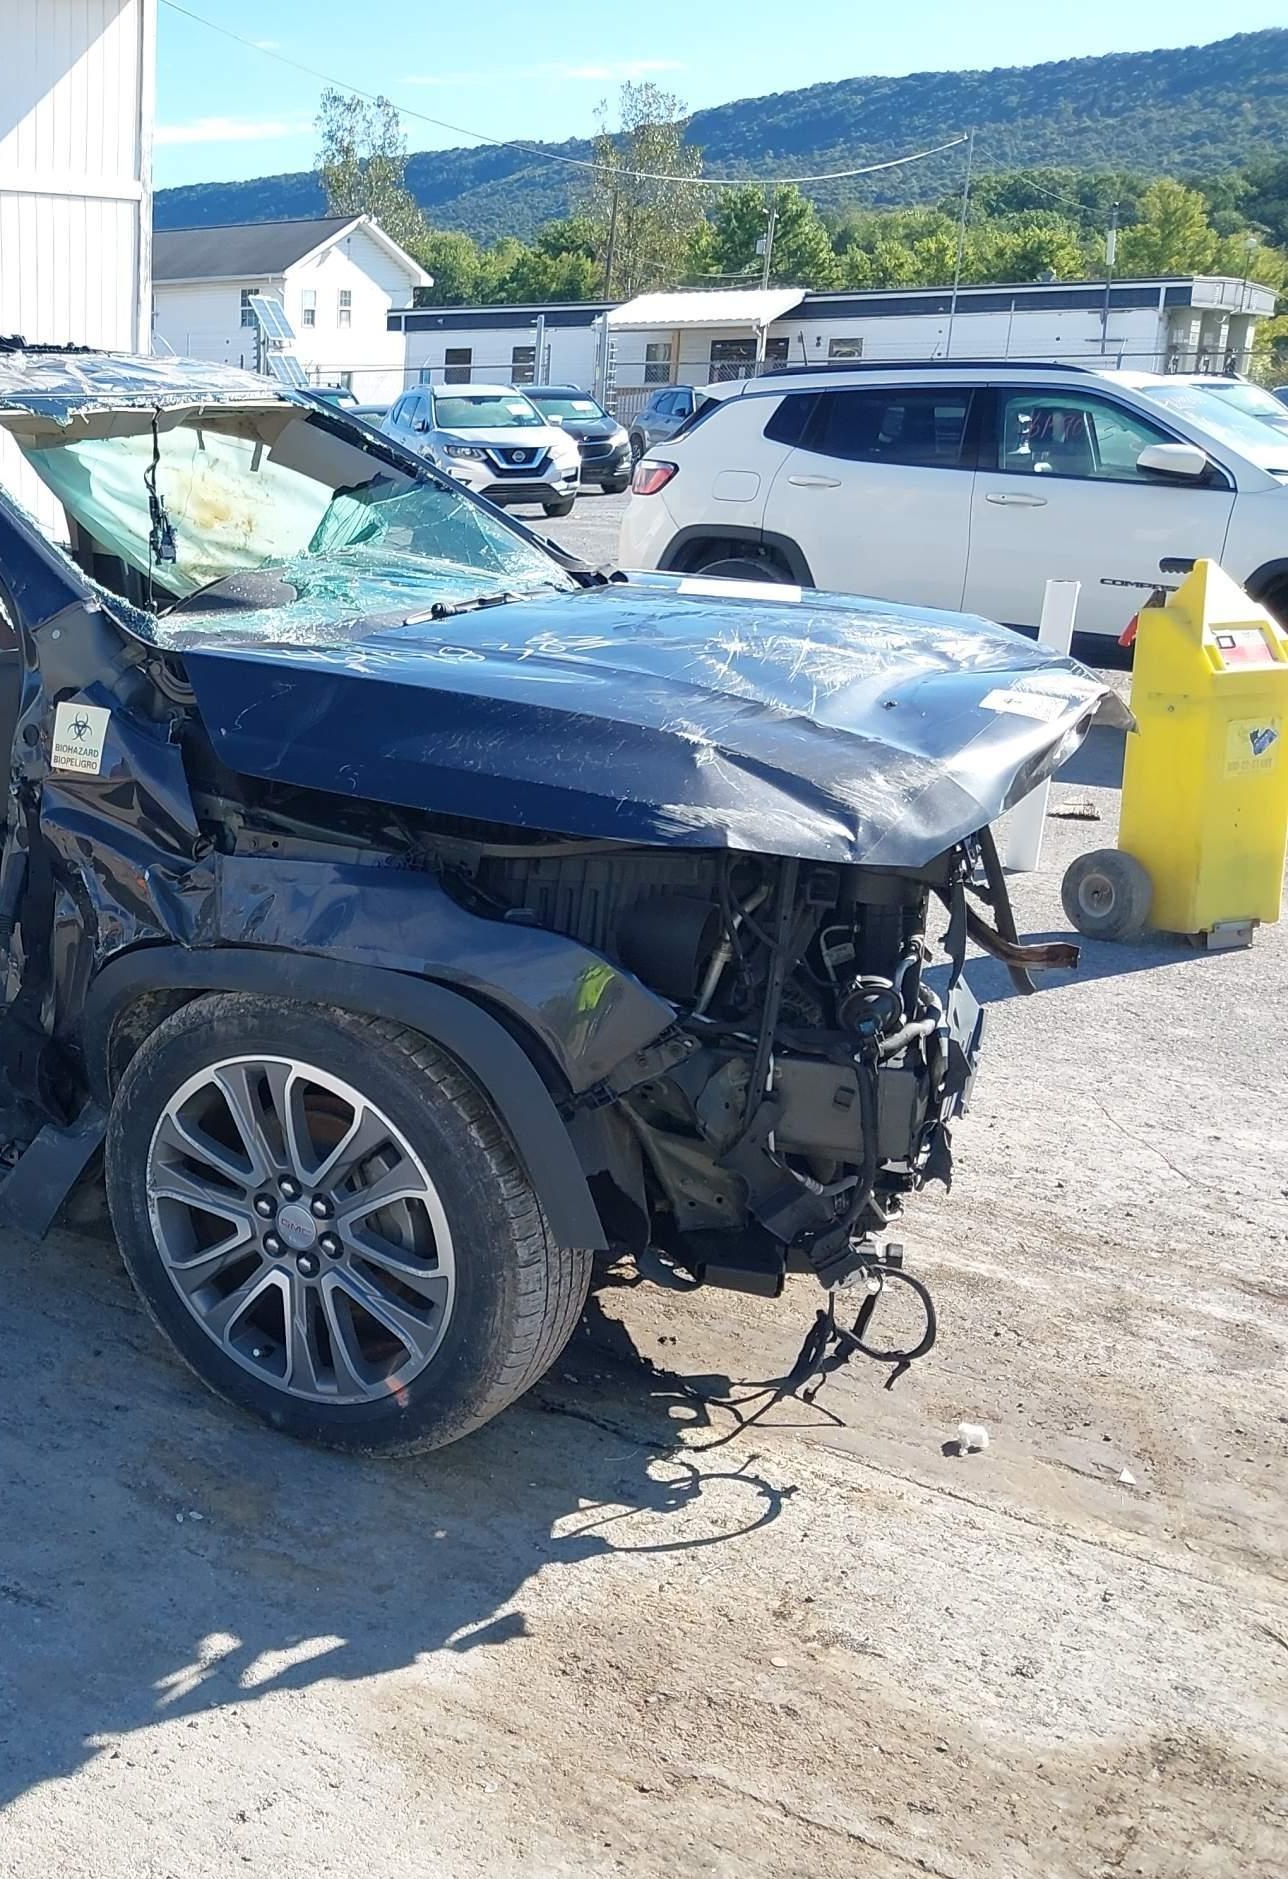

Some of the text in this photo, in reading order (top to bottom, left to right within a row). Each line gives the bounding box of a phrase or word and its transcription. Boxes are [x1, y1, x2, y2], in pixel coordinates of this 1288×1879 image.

[1100, 578, 1180, 592] COMPAS
[55, 743, 99, 758] BIOHAZARD
[53, 755, 98, 770] BIOPELIGRO
[280, 1217, 313, 1238] GMC
